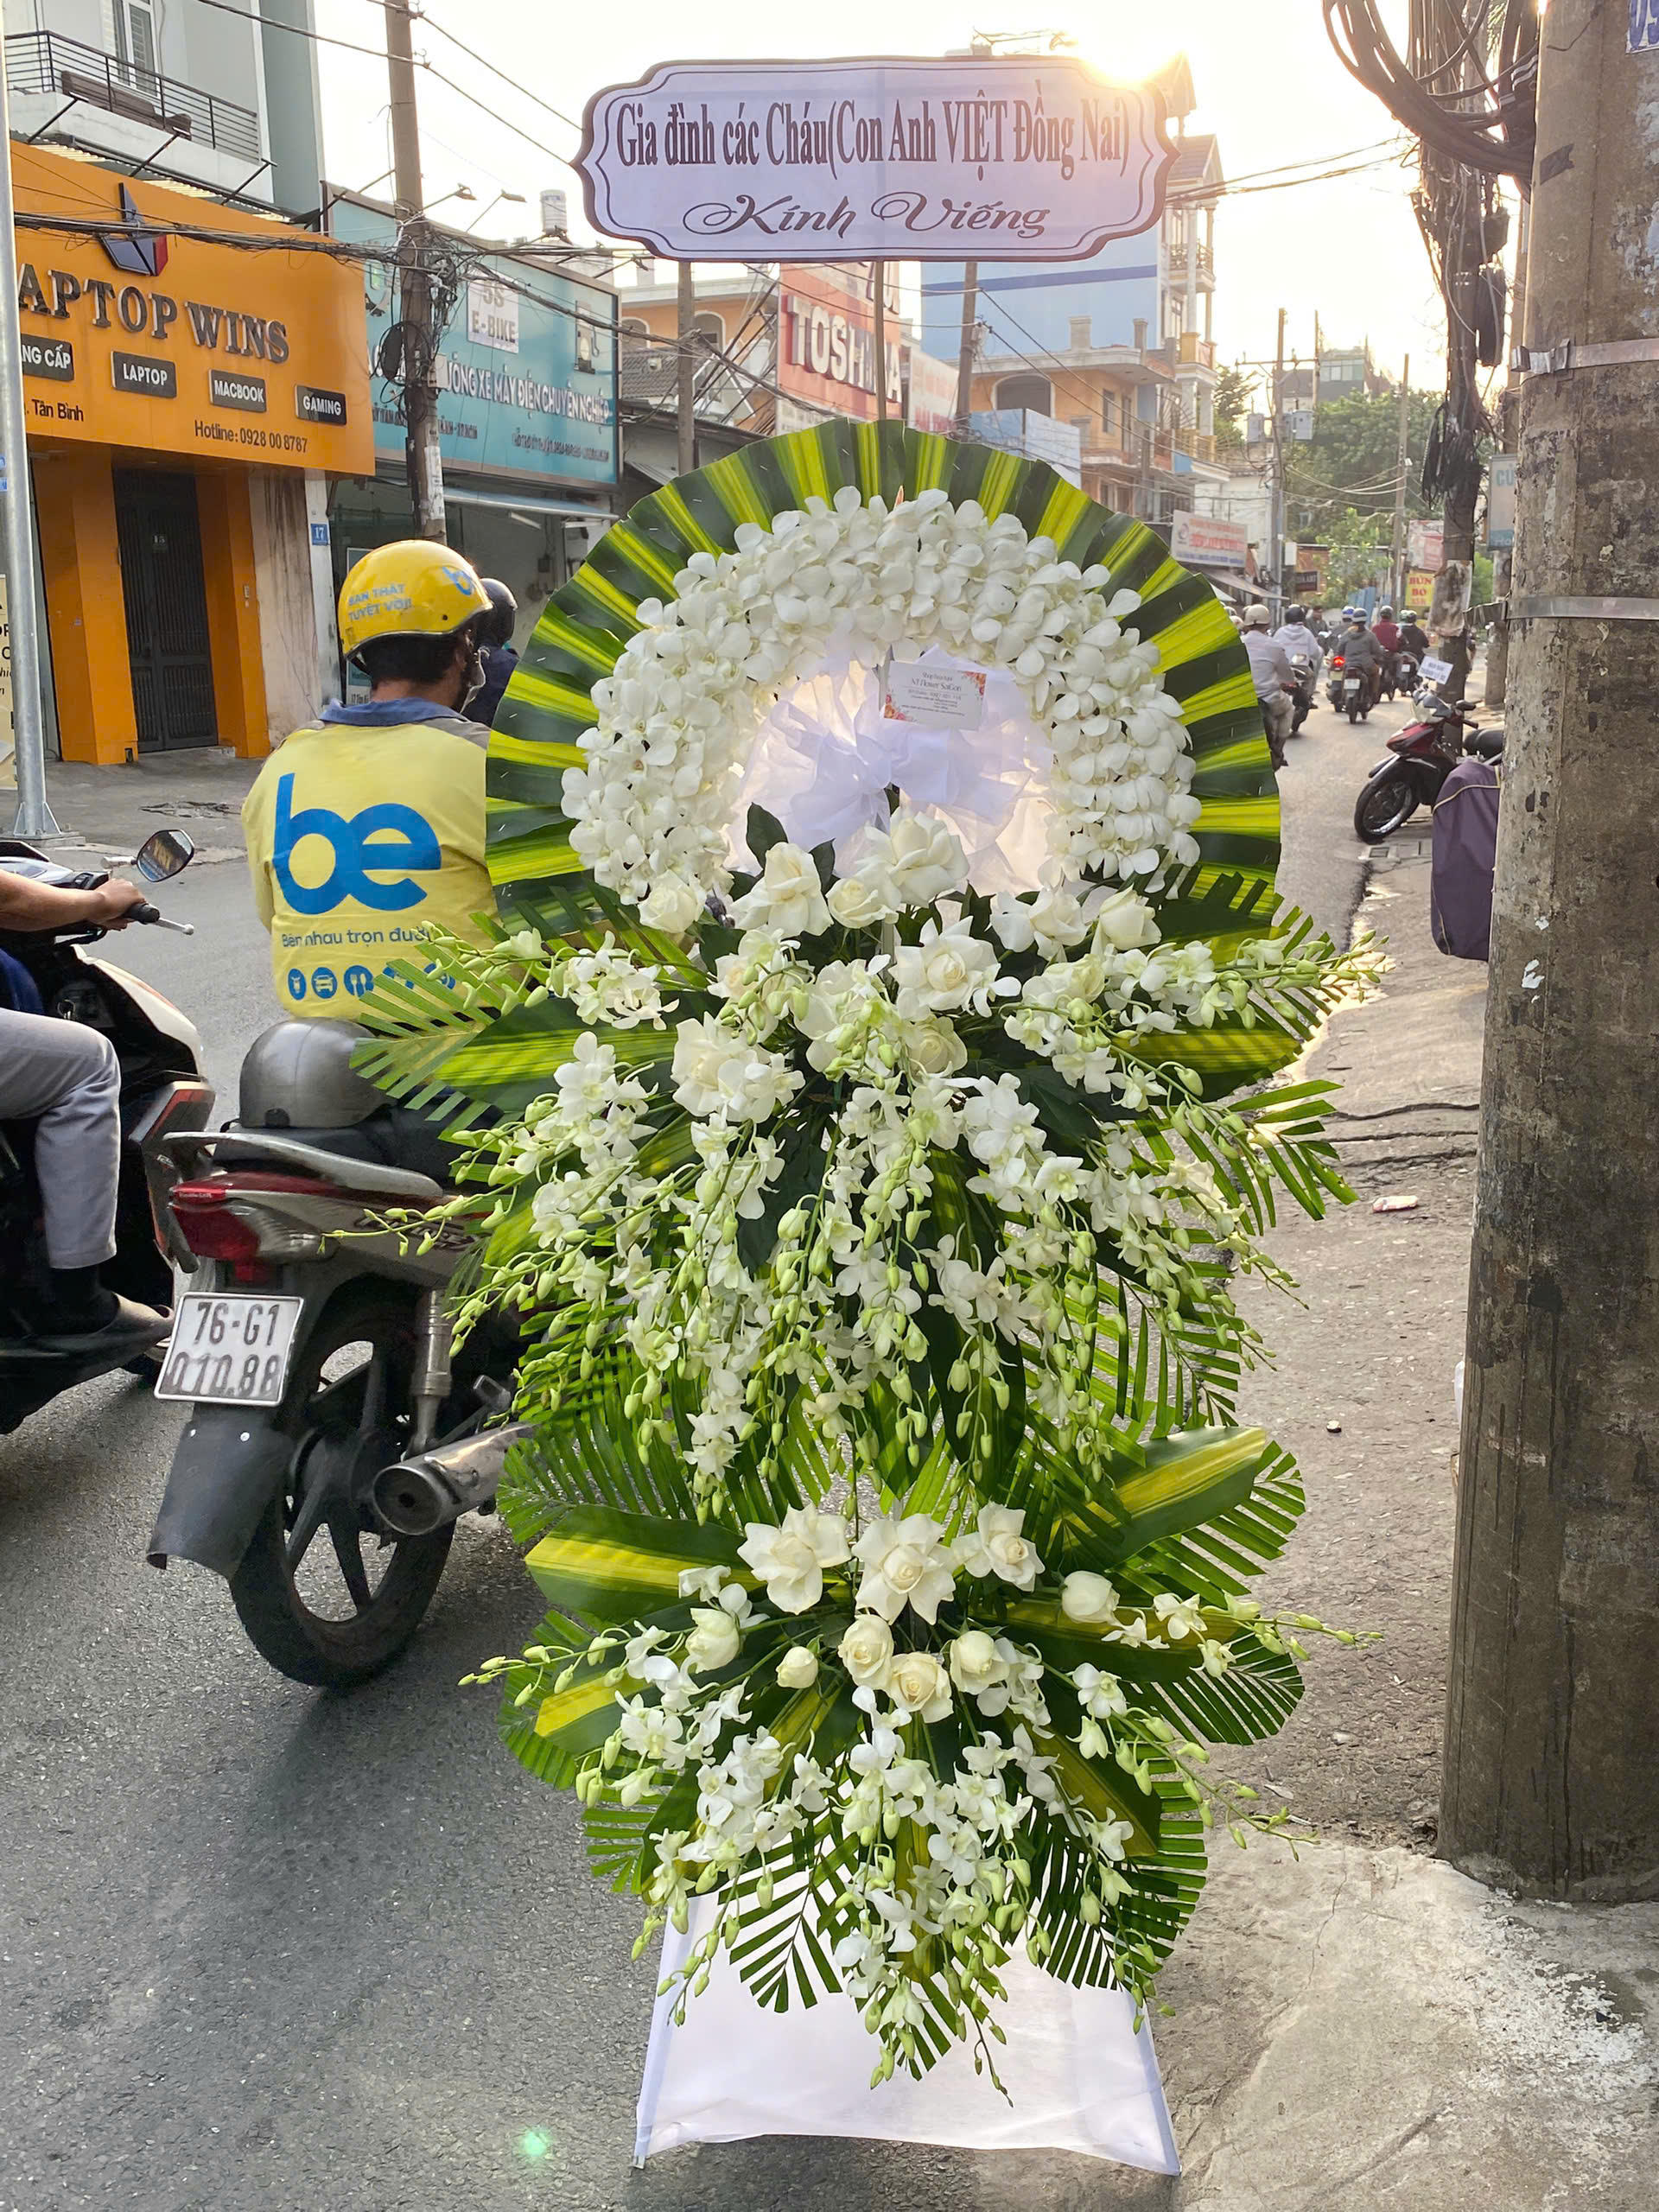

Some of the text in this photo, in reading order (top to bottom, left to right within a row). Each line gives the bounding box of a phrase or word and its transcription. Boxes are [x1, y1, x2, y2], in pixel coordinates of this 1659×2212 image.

[617, 102, 658, 166] Gia
[664, 102, 716, 166] đình
[722, 102, 760, 165] các
[888, 99, 937, 162] Anh
[942, 89, 1007, 181] VIỆT
[1013, 79, 1075, 181] Đồng
[1080, 97, 1130, 177] Nai)
[683, 191, 1051, 239] Kính Viếng
[18, 263, 177, 339] APTOP
[184, 301, 289, 364] WINS
[44, 344, 71, 370] CẤP
[787, 294, 902, 403] TOSHA
[123, 363, 168, 386] LAPTOP
[213, 379, 264, 404] MACBOOK
[477, 367, 492, 400] XE
[493, 364, 517, 407] MÁY
[31, 398, 54, 418] Tân
[57, 402, 84, 423] Bình
[302, 395, 342, 416] GAMING
[194, 419, 308, 453] Hotline: 0928 00 8787
[315, 526, 325, 539] 17
[272, 772, 442, 915] be
[282, 933, 302, 948] Bên
[305, 931, 342, 946] nhau
[346, 928, 384, 947] trọn
[193, 1301, 280, 1346] 76-G1
